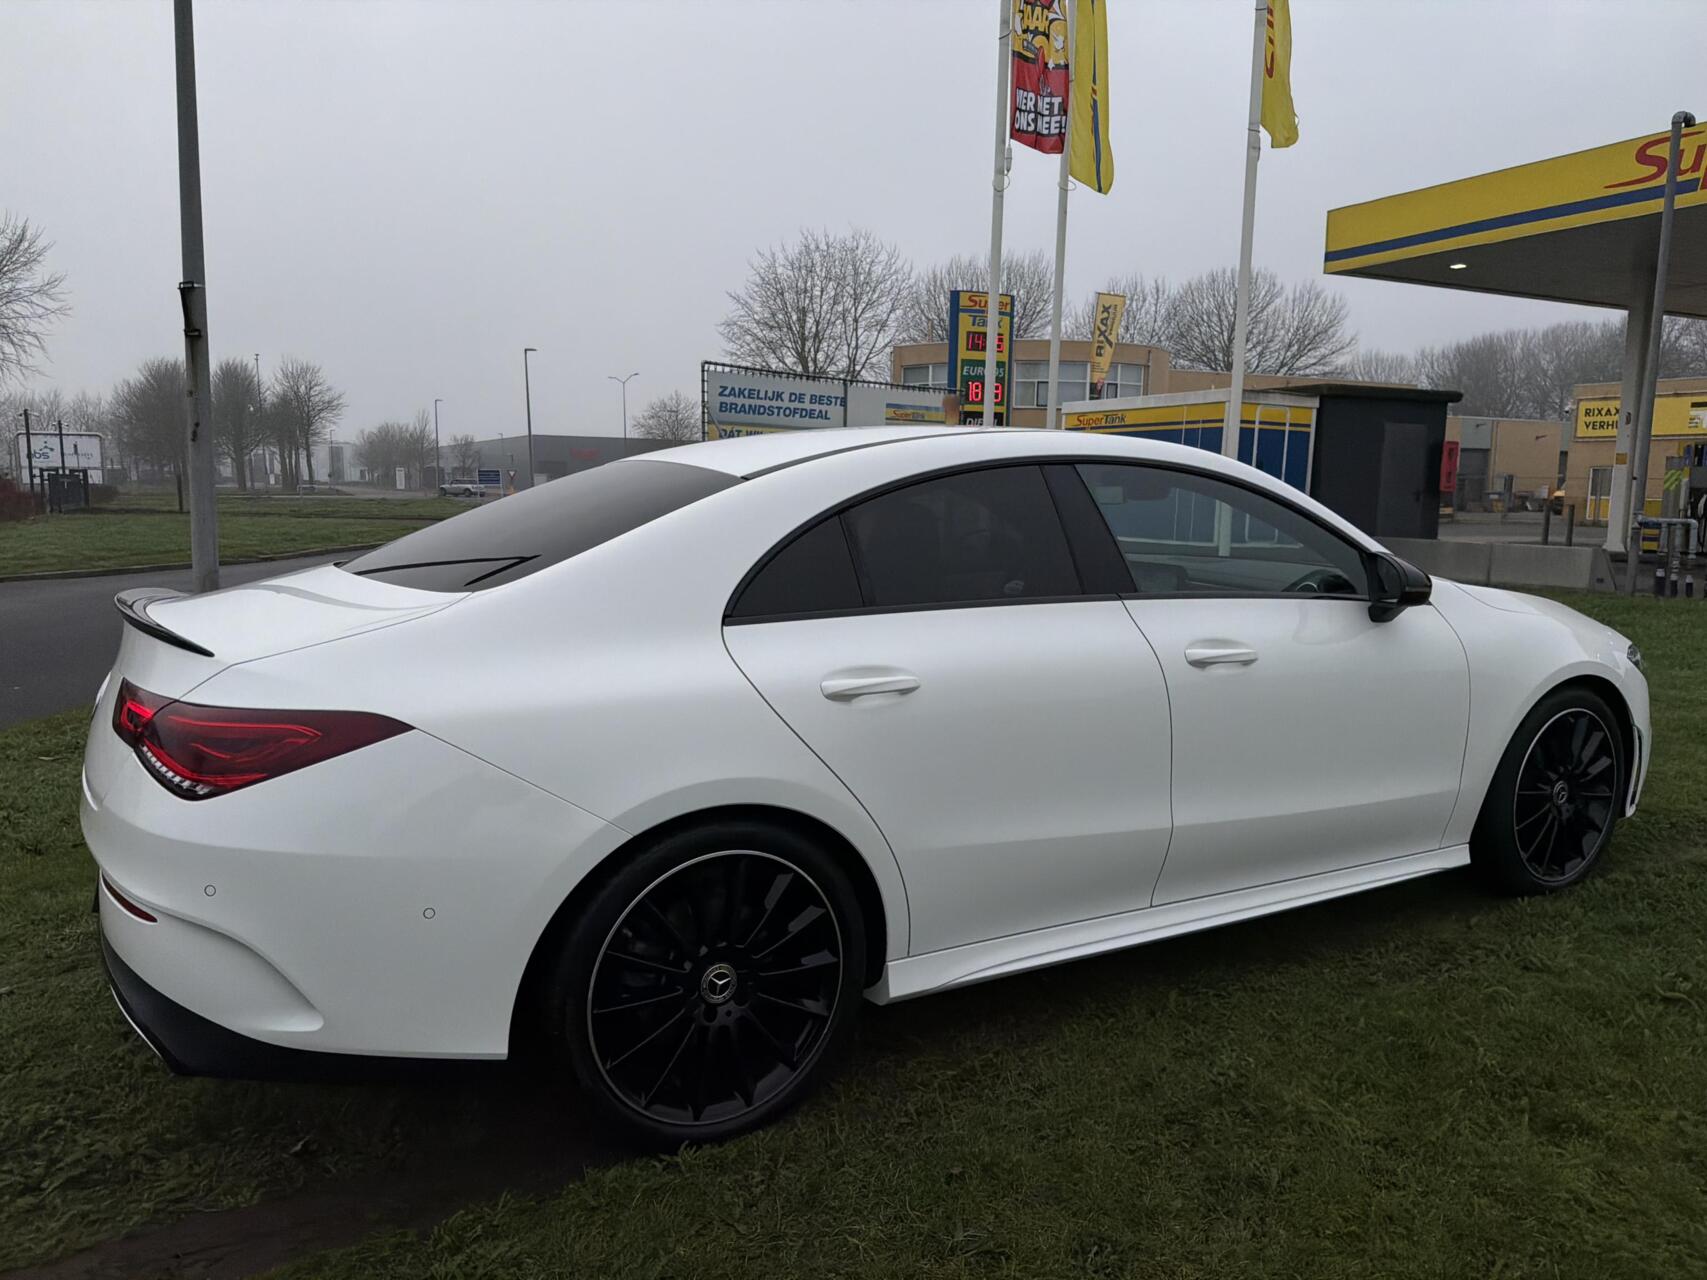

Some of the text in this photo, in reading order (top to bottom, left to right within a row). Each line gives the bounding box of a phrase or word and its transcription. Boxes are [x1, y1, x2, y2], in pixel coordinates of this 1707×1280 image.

[1014, 110, 1036, 131] ONS
[1602, 130, 1707, 190] Su
[960, 294, 1010, 315] Suer
[968, 314, 1004, 328] Ta
[968, 333, 1005, 352] 14:5
[962, 366, 987, 376] EUR
[718, 385, 847, 408] ZAKELIJK DE BESTE
[718, 401, 831, 420] BRANDSTOFDEAL
[1074, 413, 1127, 430] SuperTank
[1584, 421, 1619, 431] VERH
